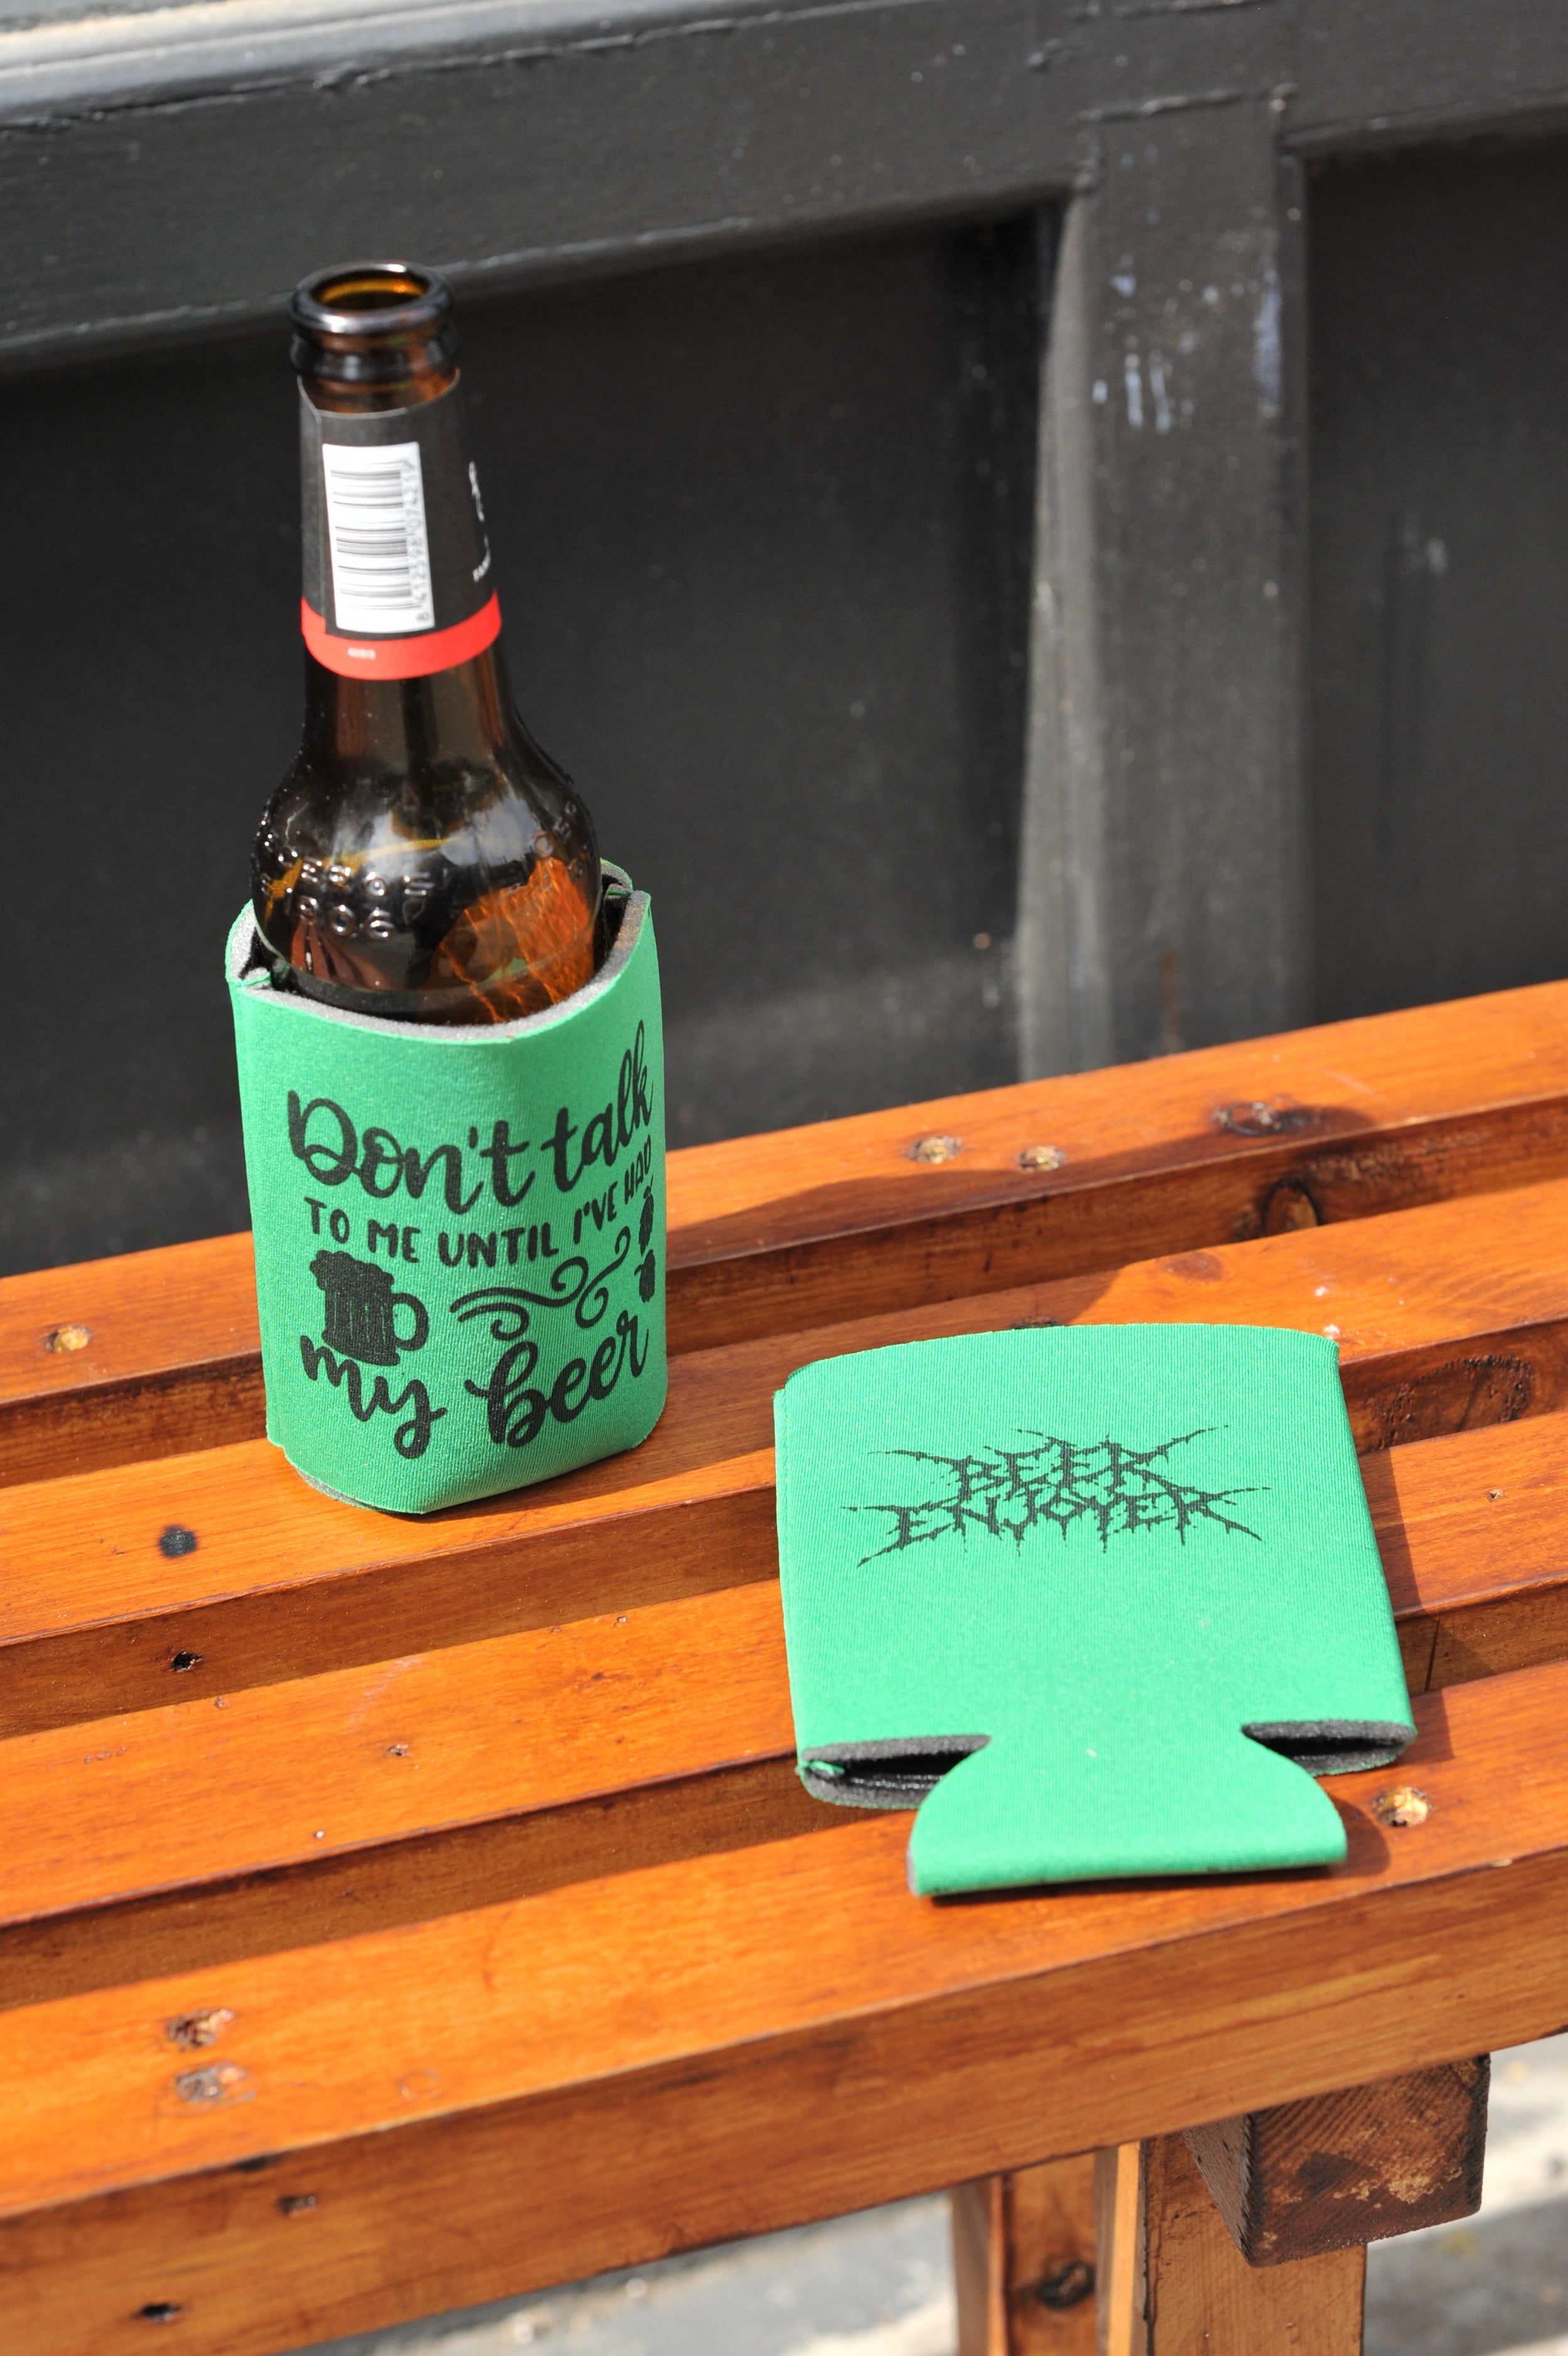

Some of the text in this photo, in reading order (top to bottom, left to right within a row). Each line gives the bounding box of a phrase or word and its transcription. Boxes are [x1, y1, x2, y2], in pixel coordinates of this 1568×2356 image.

[288, 1019, 653, 1215] Don't talk
[304, 1134, 652, 1269] TO ME UNTIL I'VE HAD
[301, 1310, 649, 1459] my beer
[840, 1484, 1272, 1568] ENJOYER
[868, 1425, 1230, 1505] BEER
